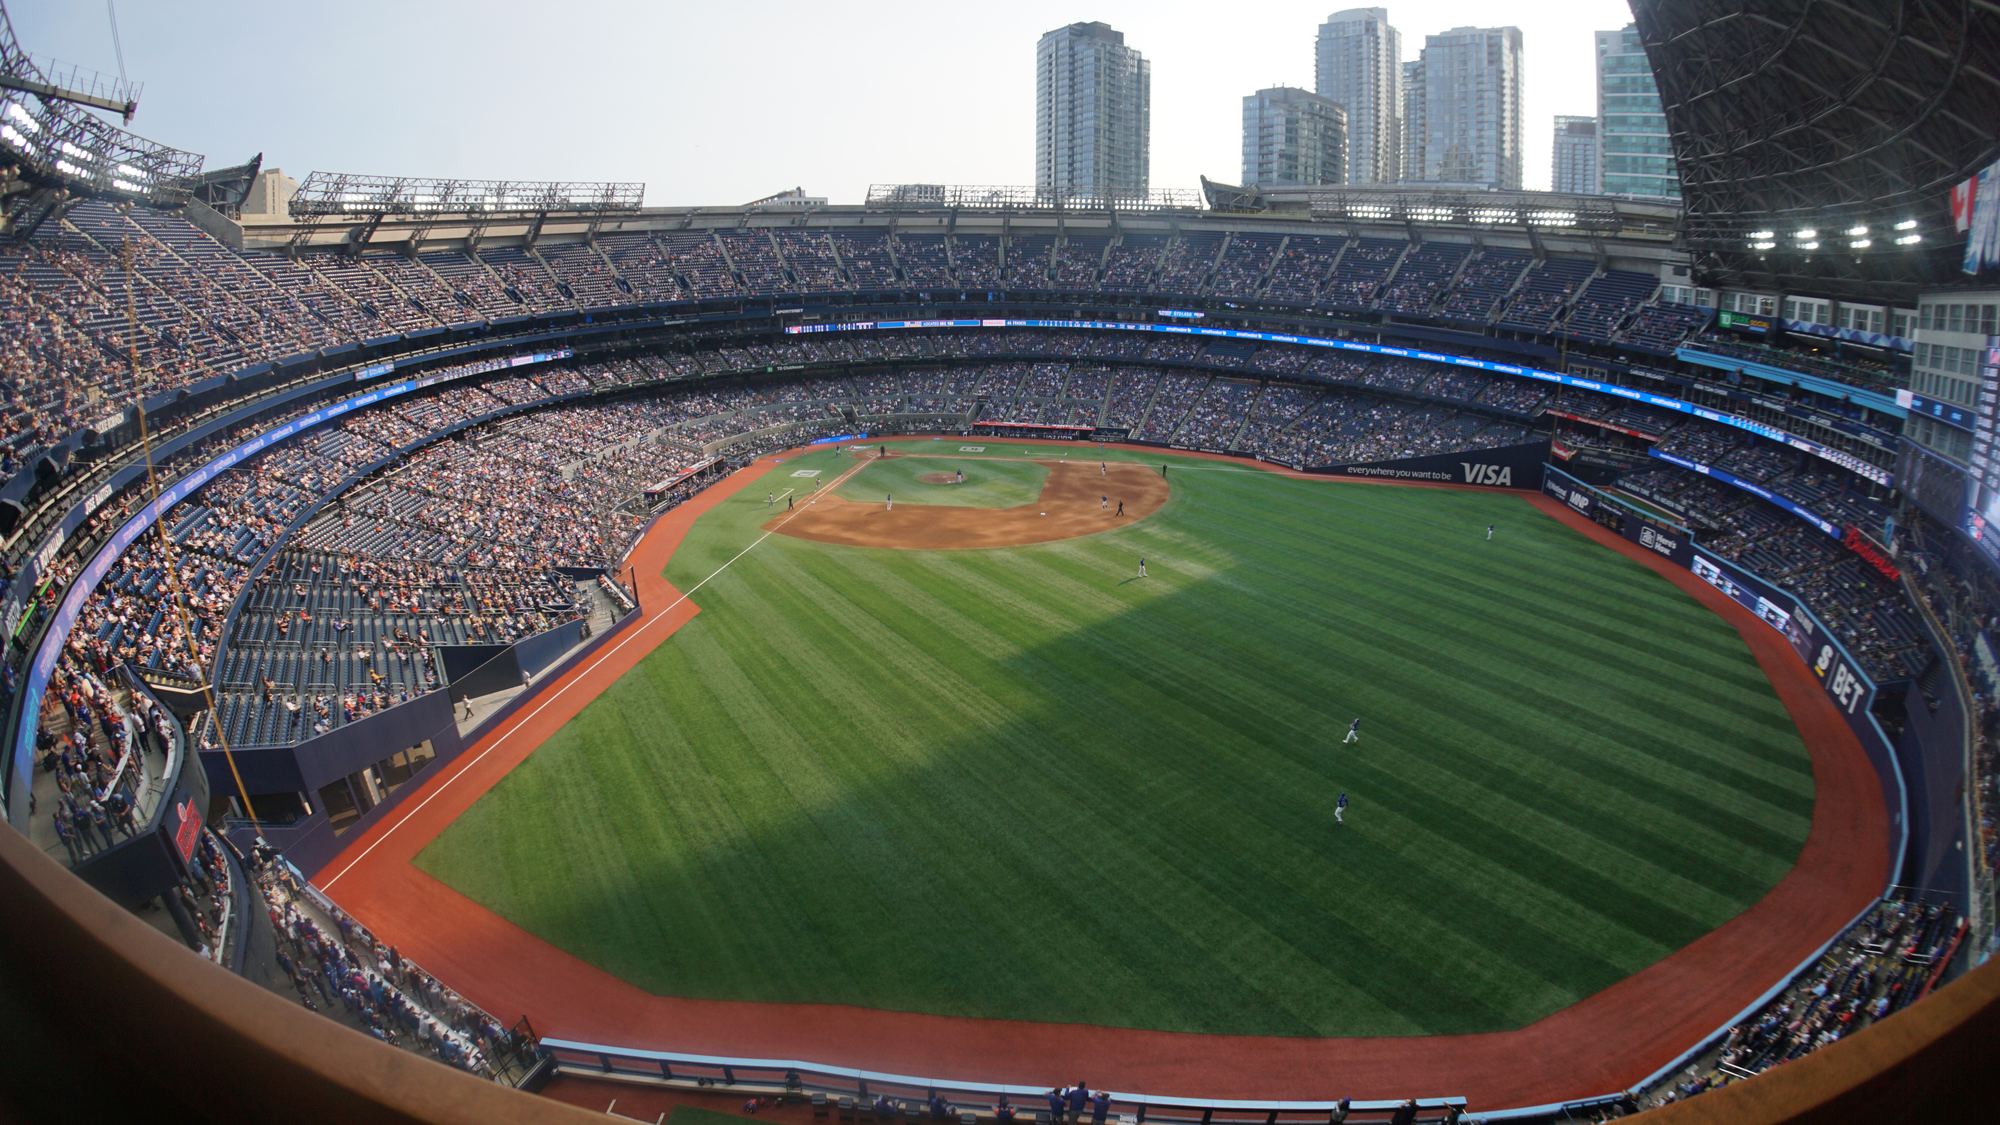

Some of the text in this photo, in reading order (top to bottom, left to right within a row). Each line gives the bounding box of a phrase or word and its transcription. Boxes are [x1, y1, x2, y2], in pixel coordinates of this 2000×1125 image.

[1347, 466, 1452, 481] everywhere you want to be
[1460, 462, 1512, 487] VISA
[1568, 490, 1590, 509] MNP
[1655, 533, 1678, 550] Here's
[1832, 663, 1864, 714] BET
